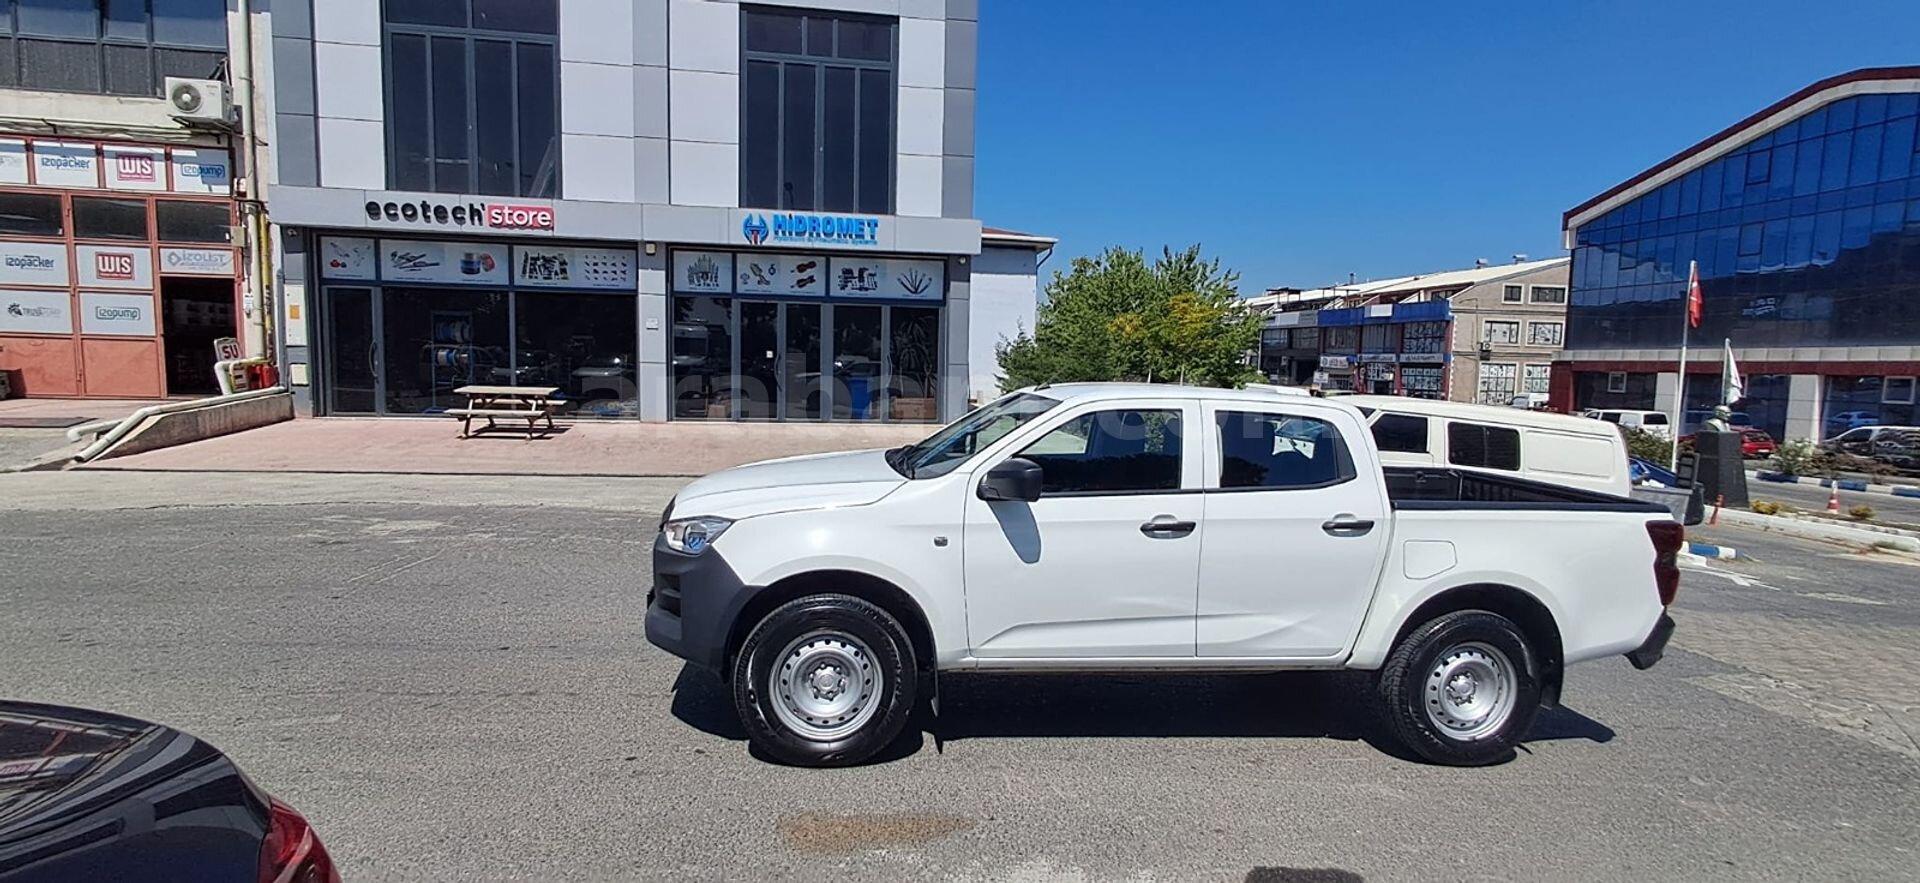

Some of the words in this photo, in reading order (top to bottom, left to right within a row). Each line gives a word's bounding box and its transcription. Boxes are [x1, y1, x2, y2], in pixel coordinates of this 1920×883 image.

[41, 156, 90, 170] izopacker
[119, 157, 152, 174] WIS
[184, 165, 223, 177] izopump
[491, 207, 551, 226] store
[5, 255, 54, 269] izopacker
[98, 255, 132, 274] WIS
[99, 308, 138, 320] izopump
[222, 344, 239, 359] SU
